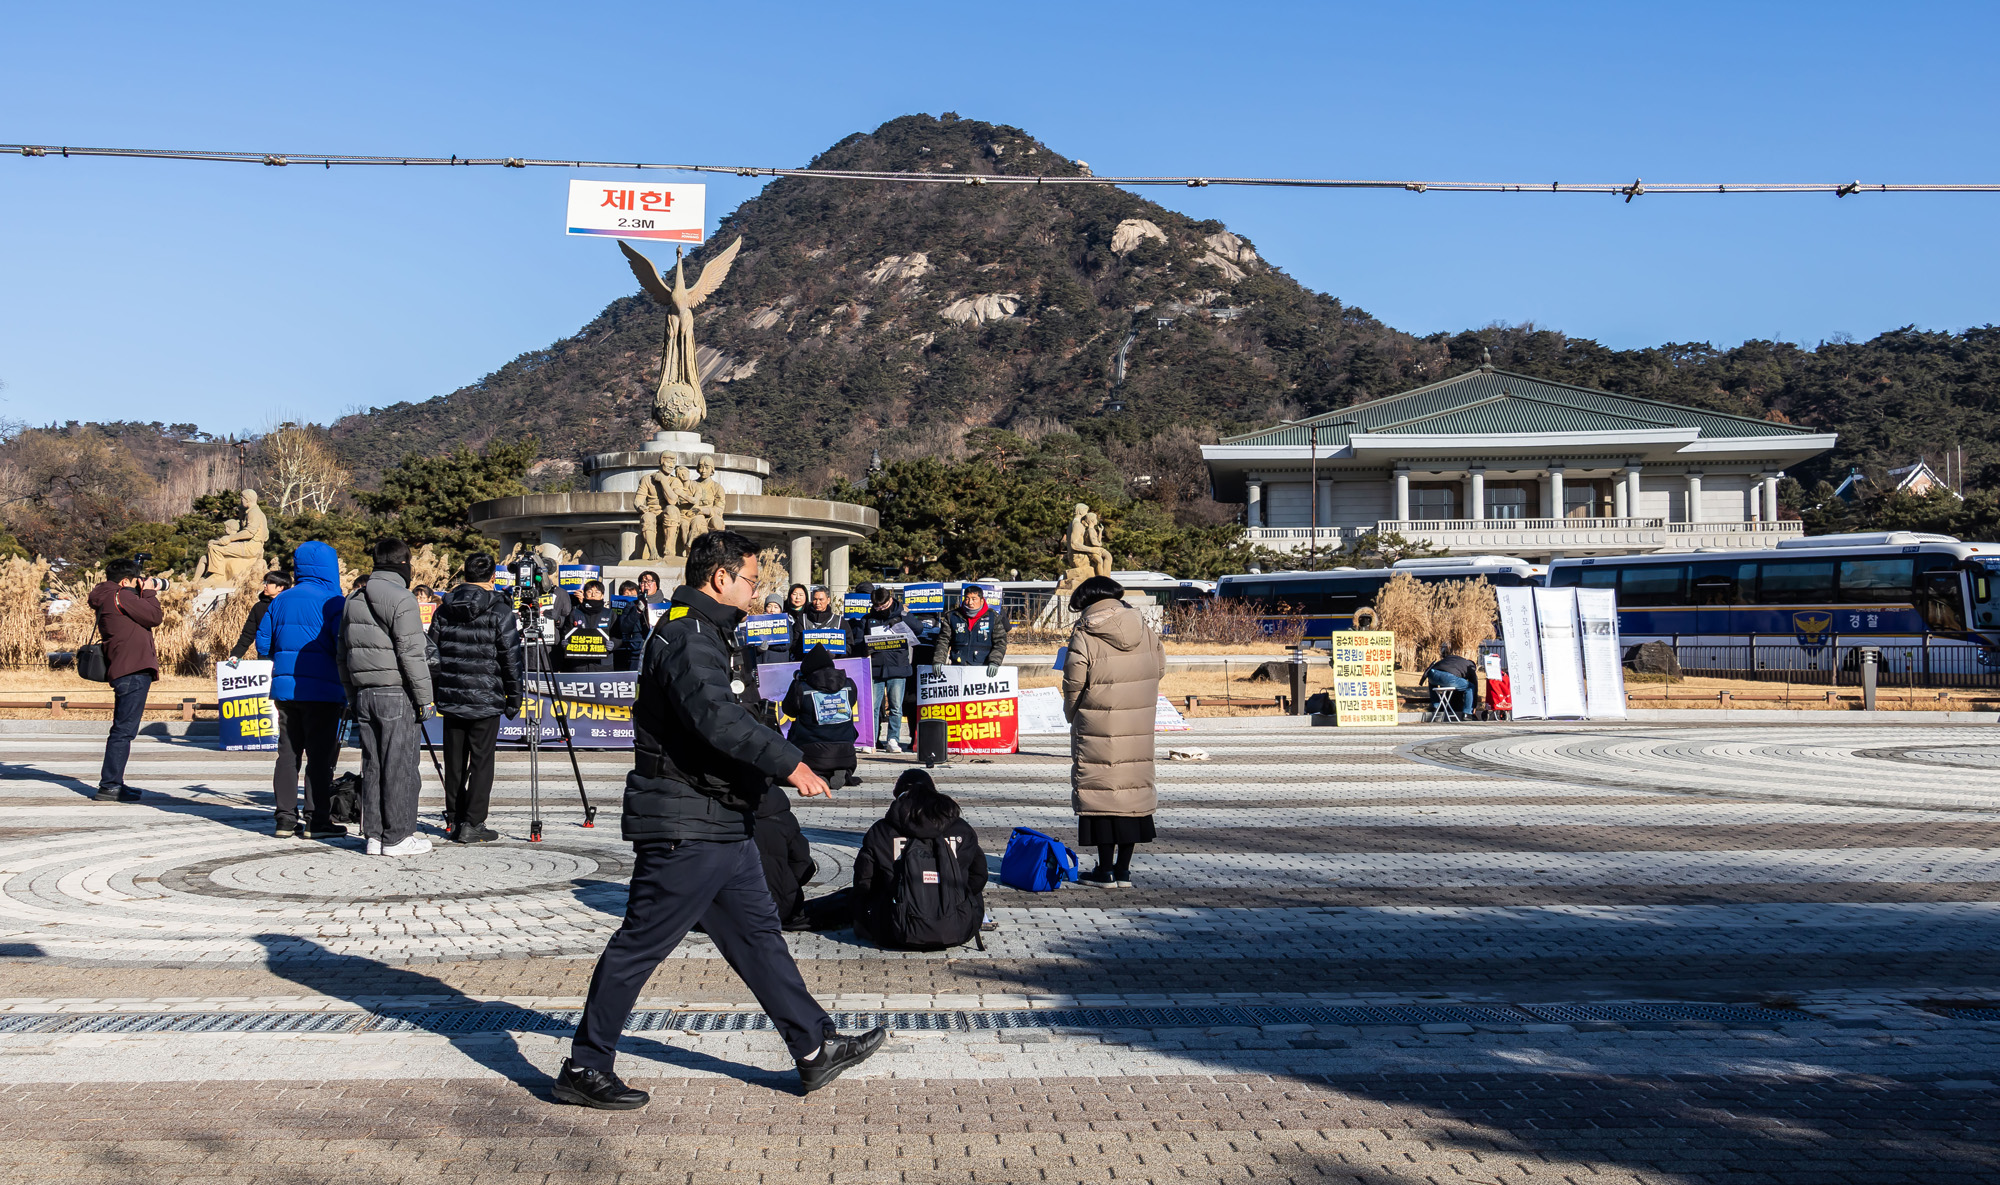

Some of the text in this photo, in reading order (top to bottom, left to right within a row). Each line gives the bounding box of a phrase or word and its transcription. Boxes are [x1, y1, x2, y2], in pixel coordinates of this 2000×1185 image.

[600, 189, 675, 213] 제한
[618, 218, 655, 229] 2.3M
[904, 589, 943, 597] 발전비정규직
[747, 619, 787, 629] 발전비정규직
[1850, 614, 1878, 628] 경찰
[748, 628, 772, 636] 정규직화
[1336, 636, 1353, 646] 공수처
[1366, 649, 1392, 662] 살인청부
[1337, 664, 1392, 677] 교통사고(즉사) 시도
[559, 681, 596, 698] 넘긴
[600, 682, 636, 698] 위험
[920, 681, 1010, 700] 중대재해 사망사고
[1338, 682, 1393, 696] 아파트 2동 강탈 시도
[550, 700, 633, 721] 이재명
[965, 699, 1014, 720] 외주화
[1339, 700, 1359, 711] 17년간
[1376, 700, 1394, 710] 독극물
[591, 728, 607, 737] 장소
